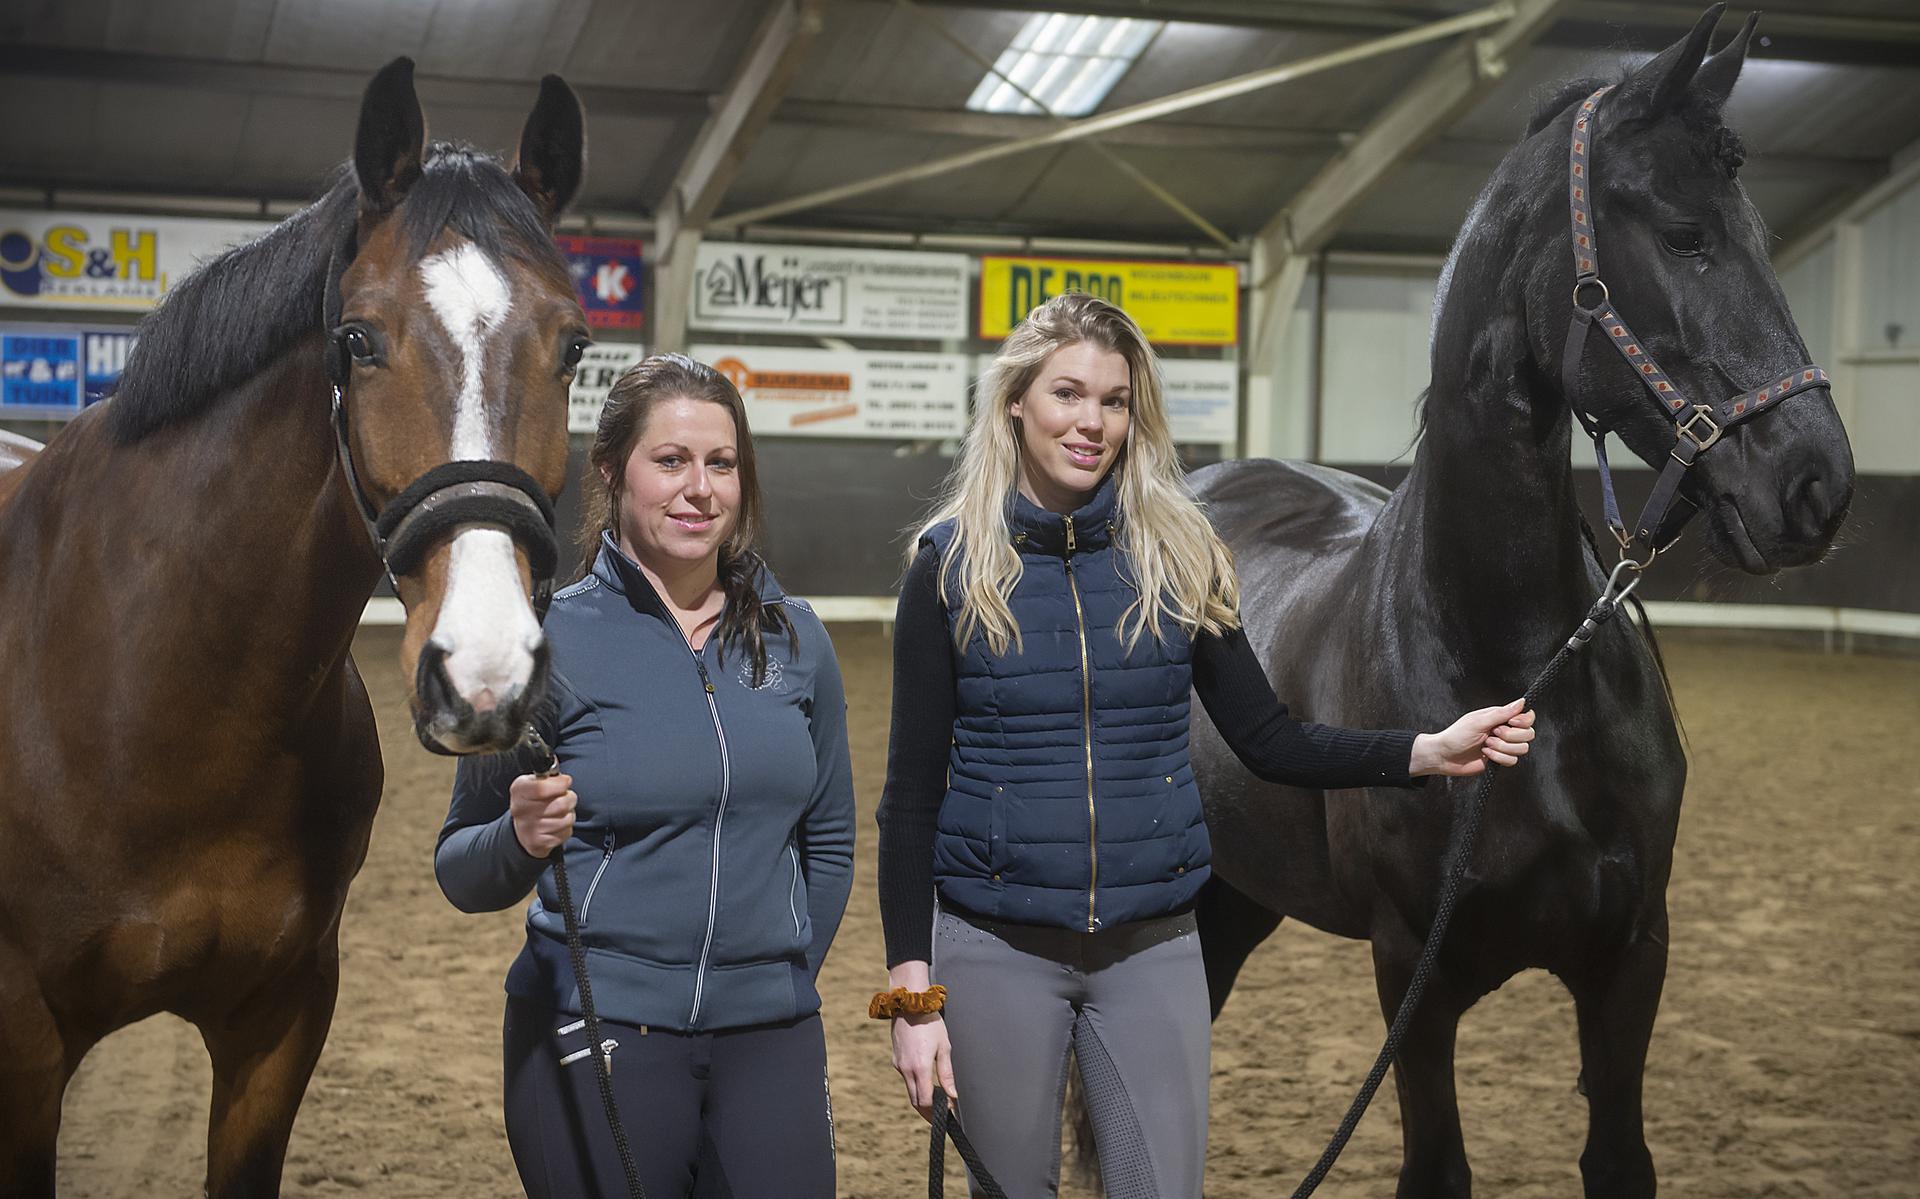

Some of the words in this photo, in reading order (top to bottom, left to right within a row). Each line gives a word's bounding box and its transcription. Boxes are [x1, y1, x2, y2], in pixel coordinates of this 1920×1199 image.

[44, 224, 157, 282] S&H
[597, 264, 629, 300] K
[734, 254, 830, 322] Meijer
